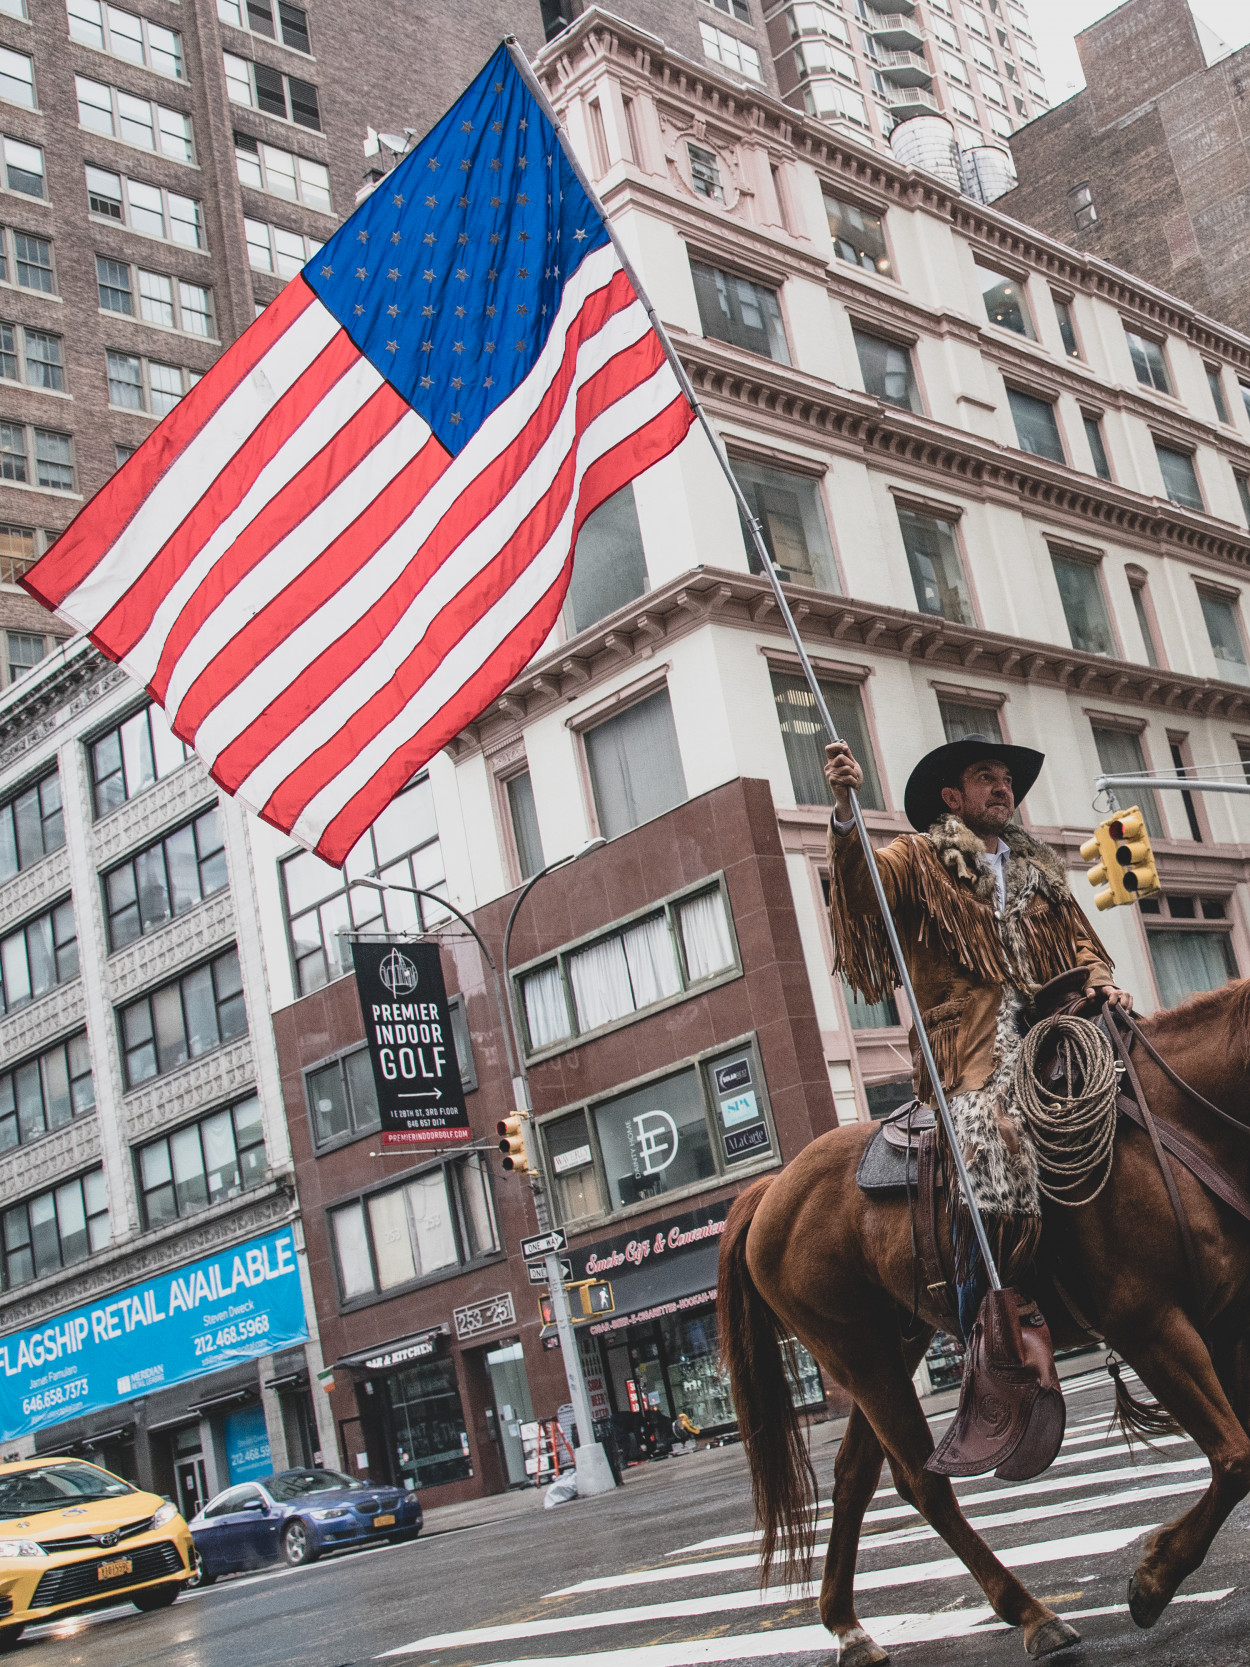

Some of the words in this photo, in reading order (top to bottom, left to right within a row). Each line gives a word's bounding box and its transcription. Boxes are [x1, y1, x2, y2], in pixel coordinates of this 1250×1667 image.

[372, 1003, 440, 1022] PREMIER
[375, 1024, 444, 1045] INDOOR
[379, 1046, 446, 1080] GOLF
[394, 1110, 399, 1118] E
[425, 1107, 439, 1117] 3RD
[440, 1106, 459, 1115] FLOOR
[388, 1130, 468, 1142] PREMIERINDOORGOLF.COM
[625, 1120, 635, 1147] HOME
[630, 1149, 641, 1180] DAINTY
[528, 1242, 541, 1252] ONE
[545, 1237, 559, 1247] WAY
[585, 1250, 625, 1275] Smoke
[625, 1240, 650, 1265] Gift
[653, 1232, 666, 1254] &
[531, 1269, 546, 1278] ONE
[91, 1290, 165, 1343] RETAIL
[168, 1237, 295, 1316] AVAILABLE
[203, 1306, 229, 1327] Steven
[229, 1299, 255, 1320] Dweck
[194, 1314, 270, 1356] 212.468.5968
[366, 1356, 383, 1368] BAR
[384, 1354, 392, 1366] &
[392, 1341, 433, 1362] KITCHEN
[130, 1364, 164, 1382] MERIDIAN
[23, 1378, 89, 1415] 646.658.7373
